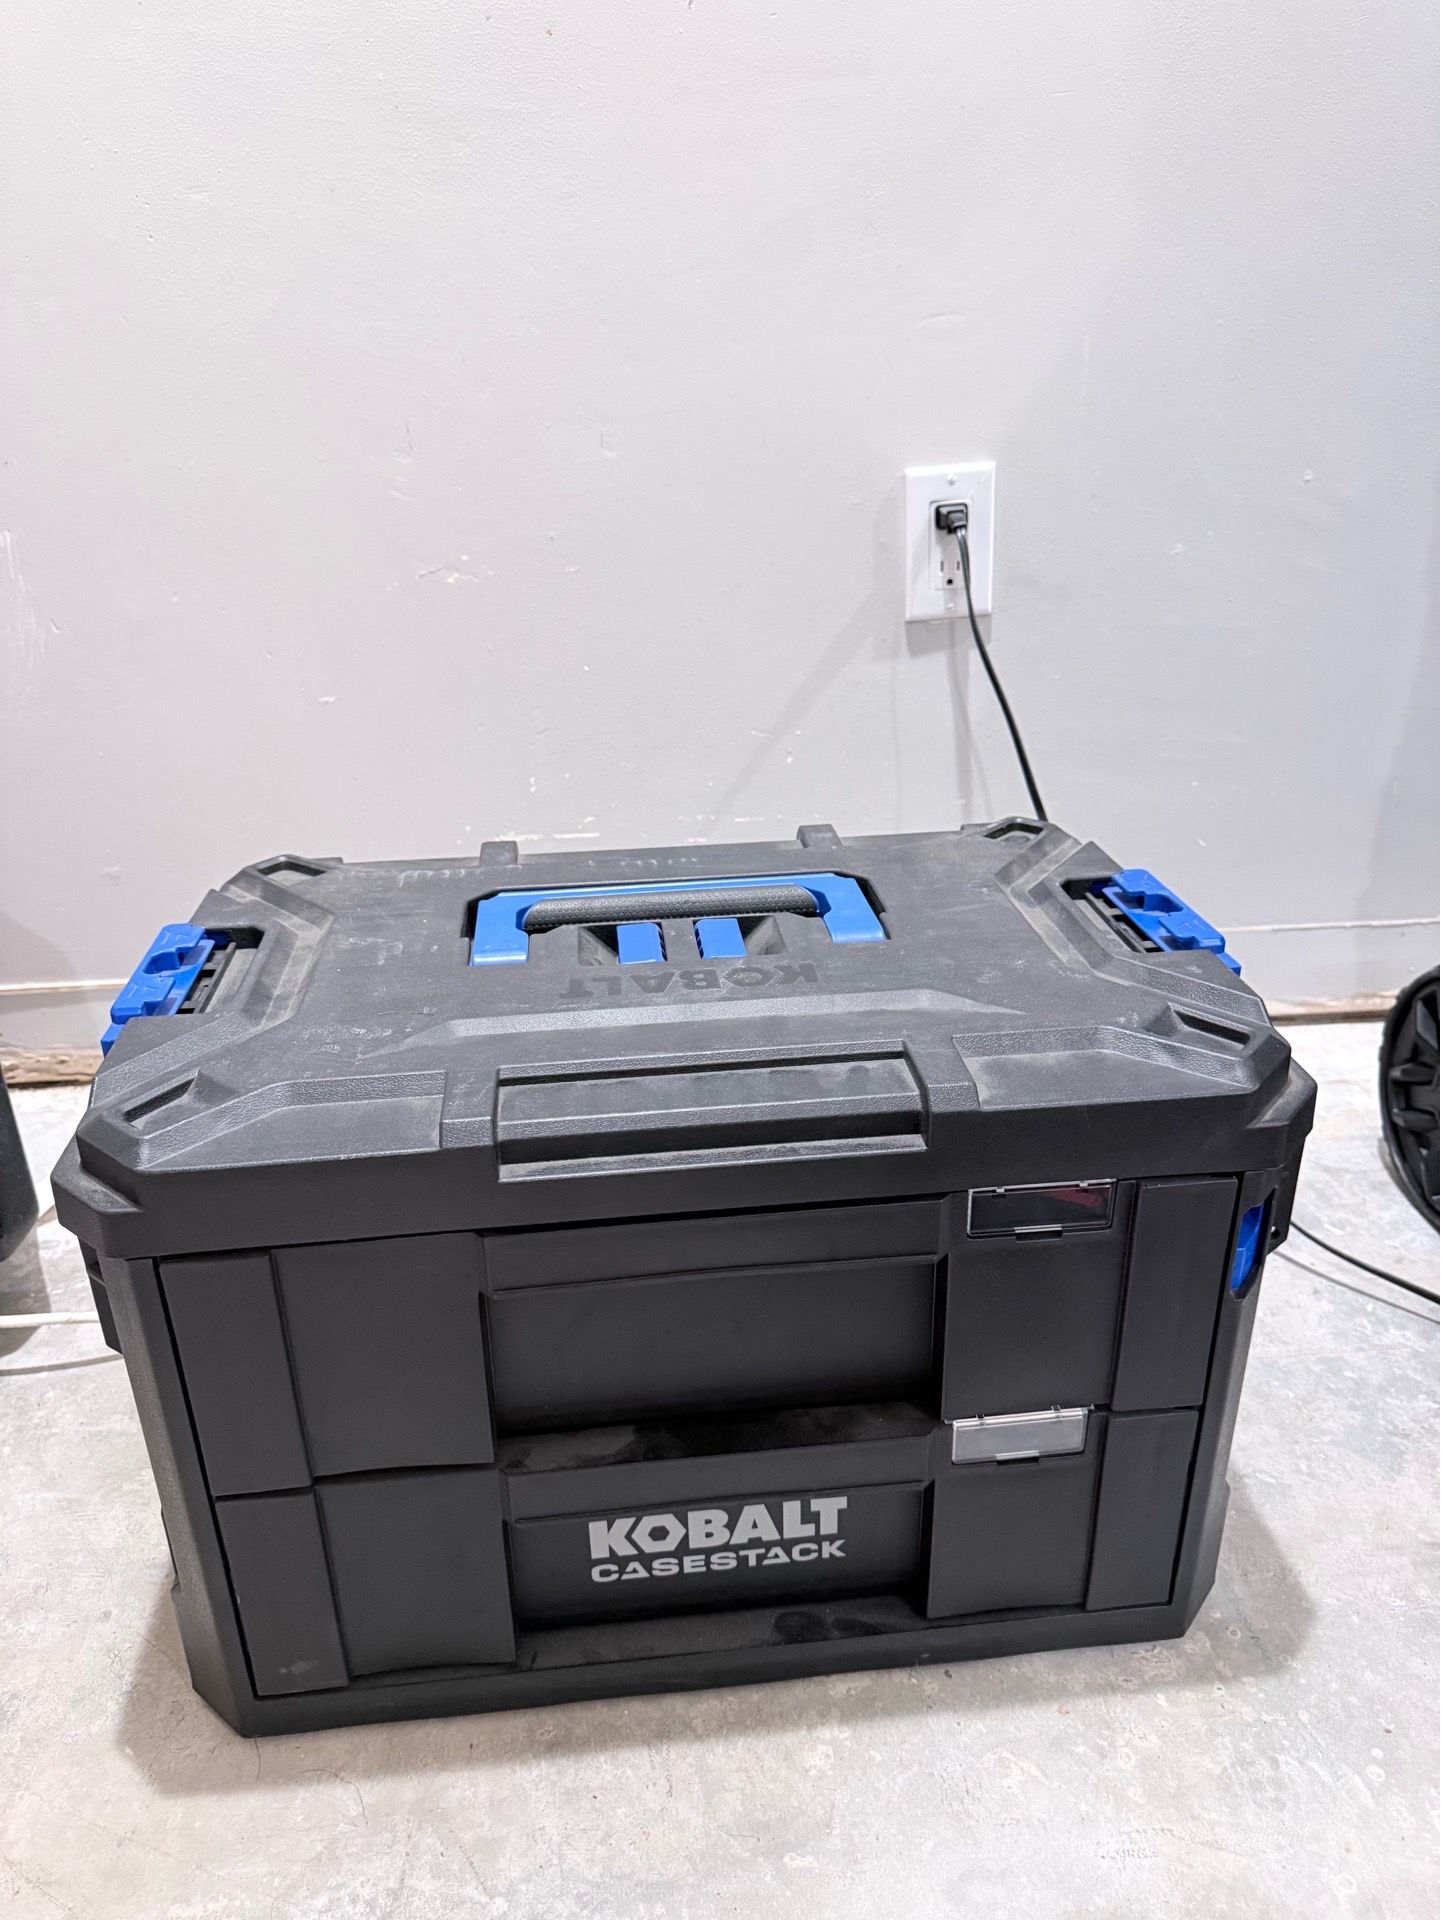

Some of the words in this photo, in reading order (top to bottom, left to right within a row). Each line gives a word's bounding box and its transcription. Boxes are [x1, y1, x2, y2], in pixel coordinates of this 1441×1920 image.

[559, 961, 819, 999] KOBALT
[588, 1495, 848, 1560] KOBALT
[590, 1539, 847, 1583] CASESTACK
